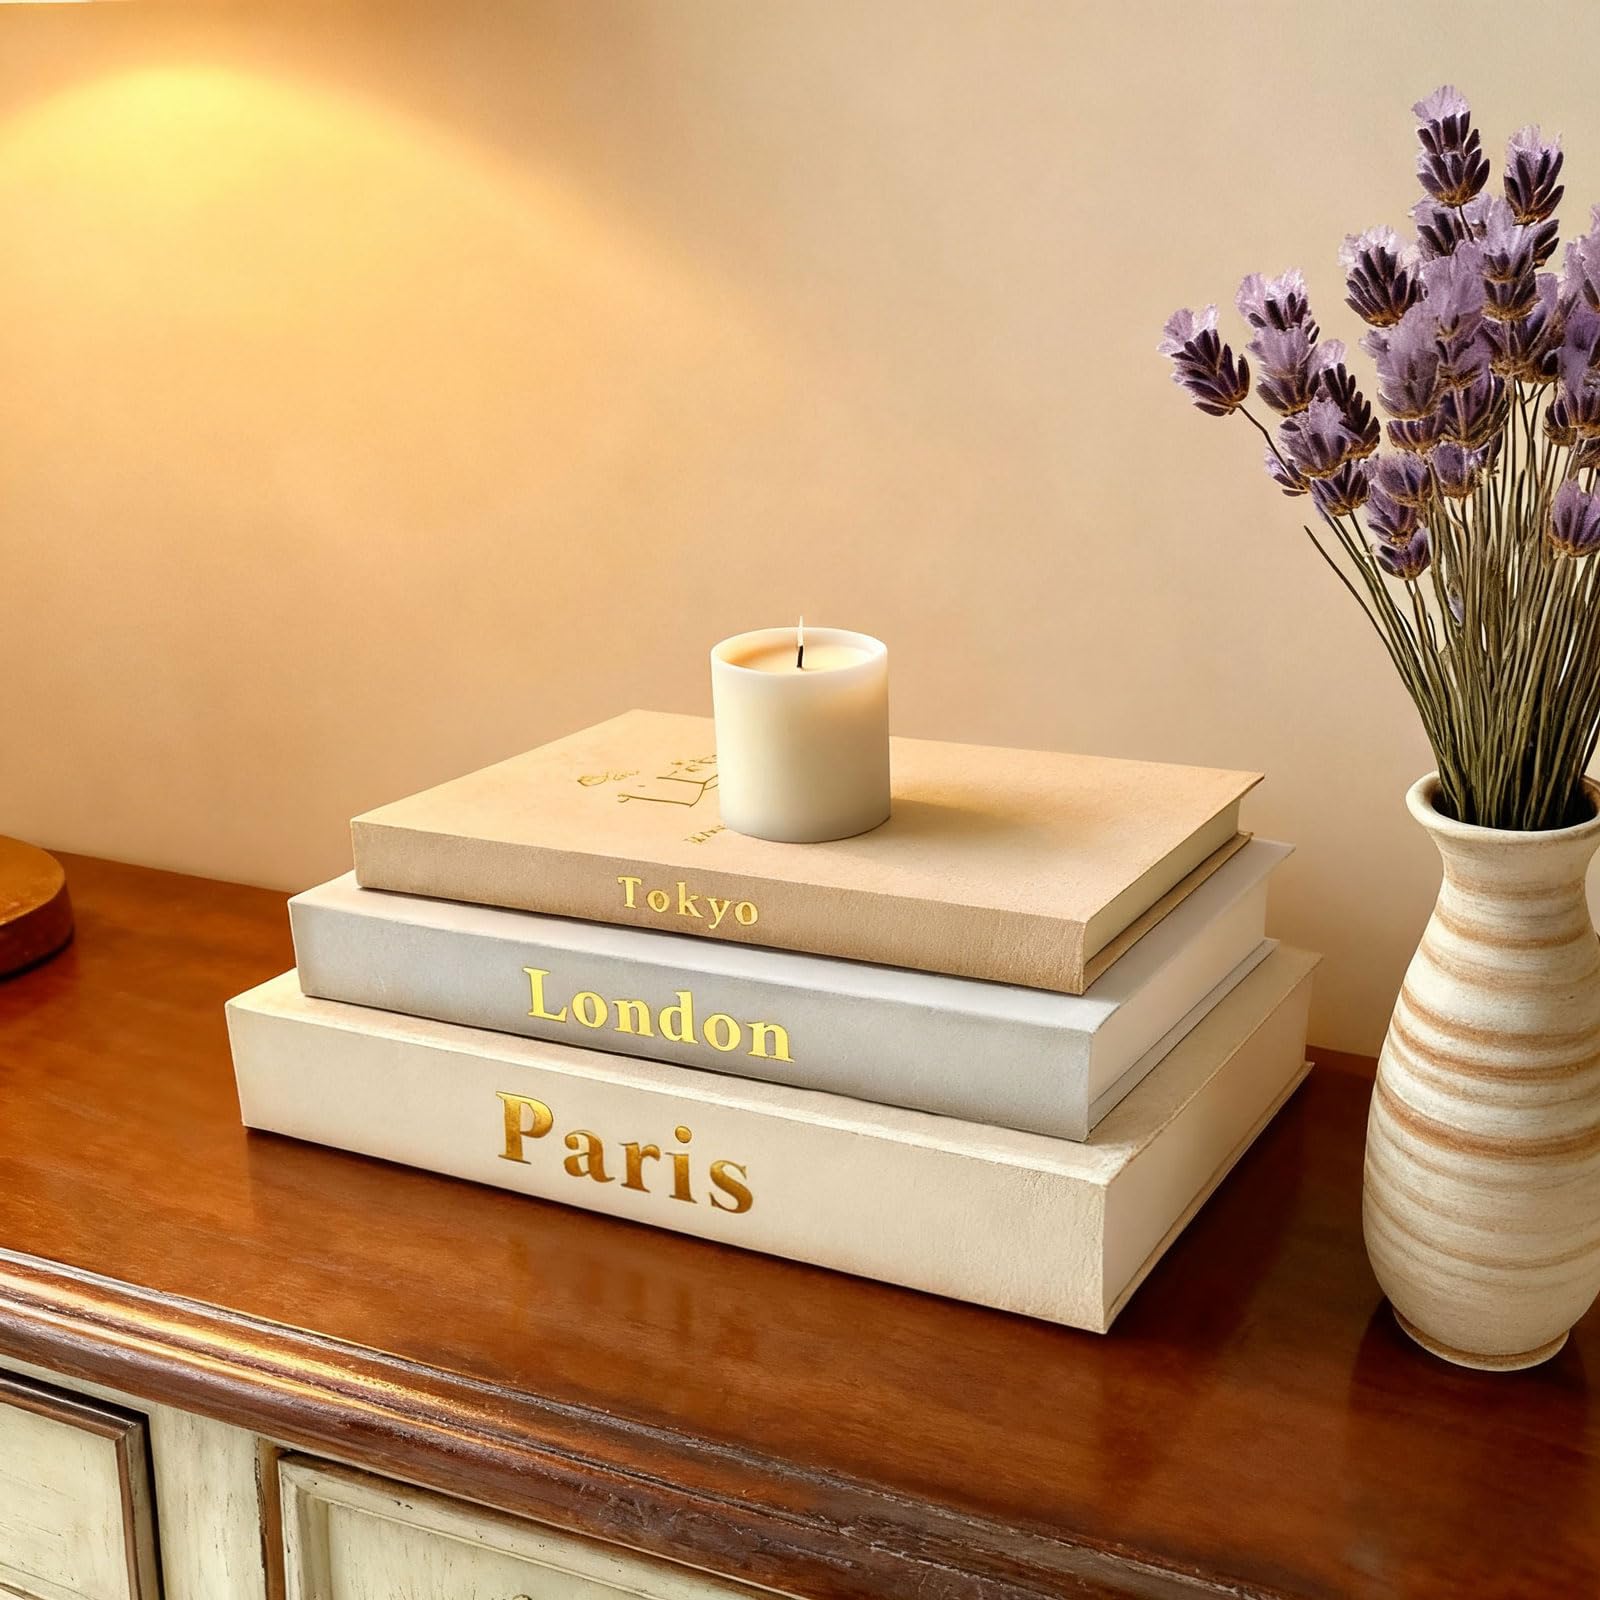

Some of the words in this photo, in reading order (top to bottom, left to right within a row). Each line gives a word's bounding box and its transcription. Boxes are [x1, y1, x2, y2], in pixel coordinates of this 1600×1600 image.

[617, 876, 760, 929] Tokyo
[522, 967, 795, 1063] London
[495, 1091, 754, 1214] Paris
